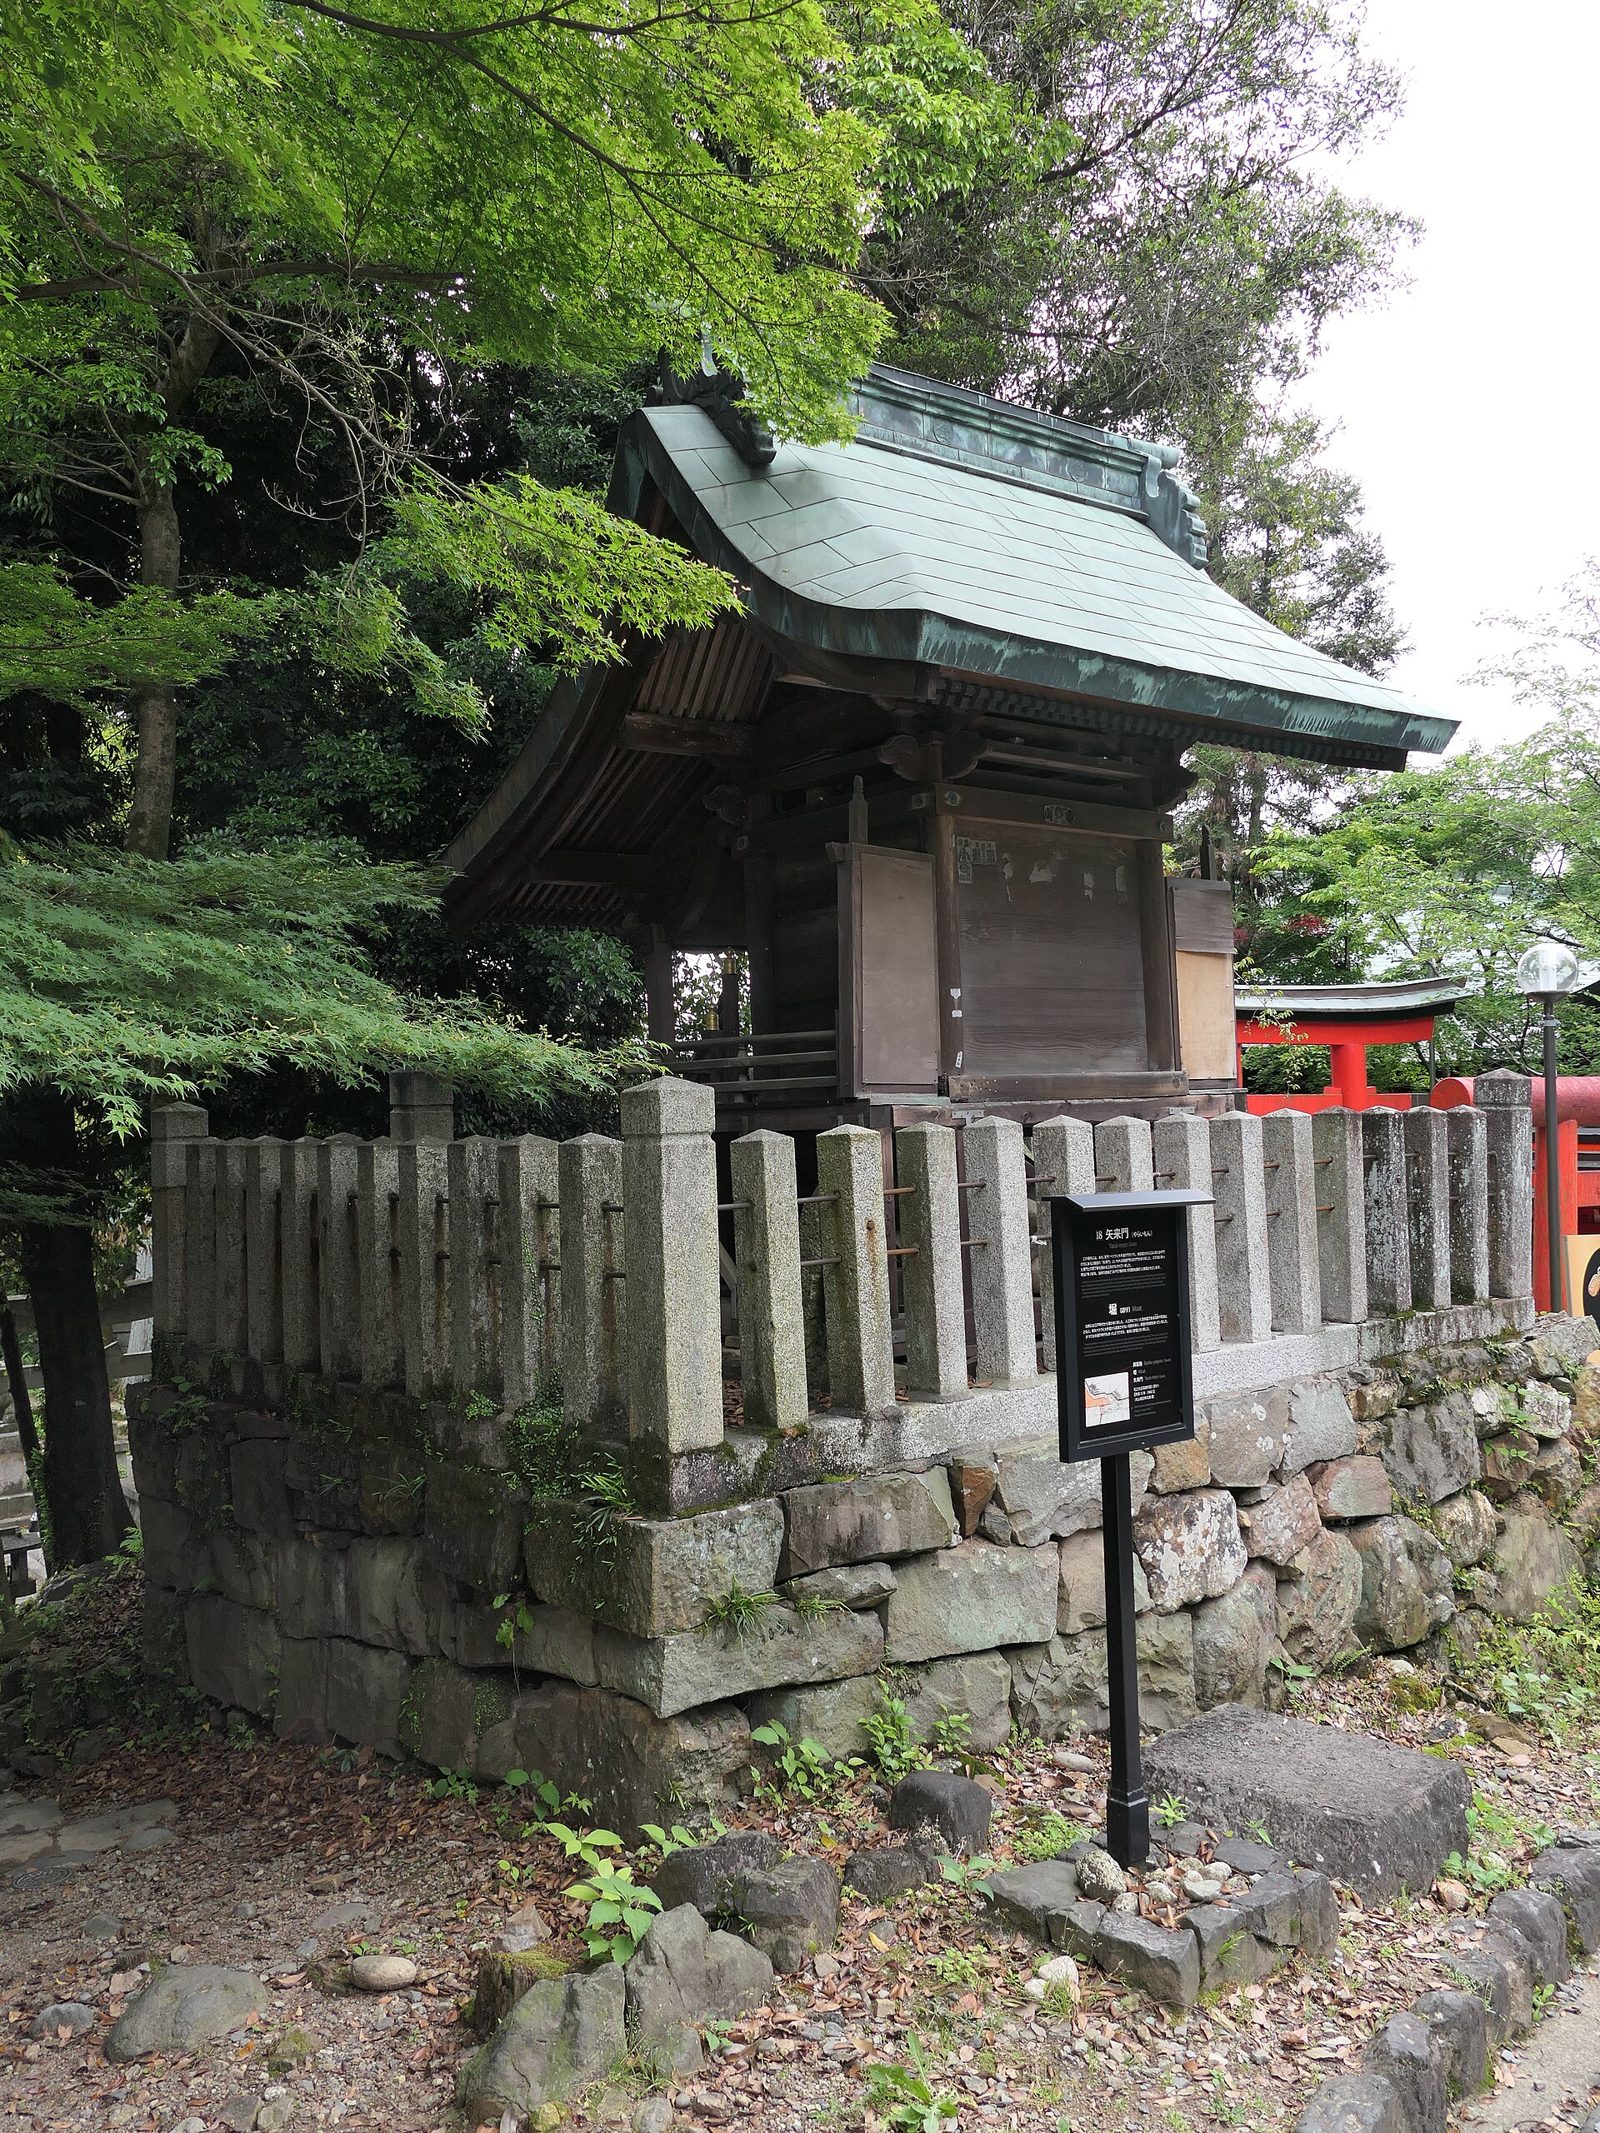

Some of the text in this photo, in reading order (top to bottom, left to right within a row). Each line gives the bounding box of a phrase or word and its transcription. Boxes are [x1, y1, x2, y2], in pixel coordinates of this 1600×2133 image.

[1096, 1230, 1103, 1240] 18
[1105, 1227, 1129, 1241] 矢来門
